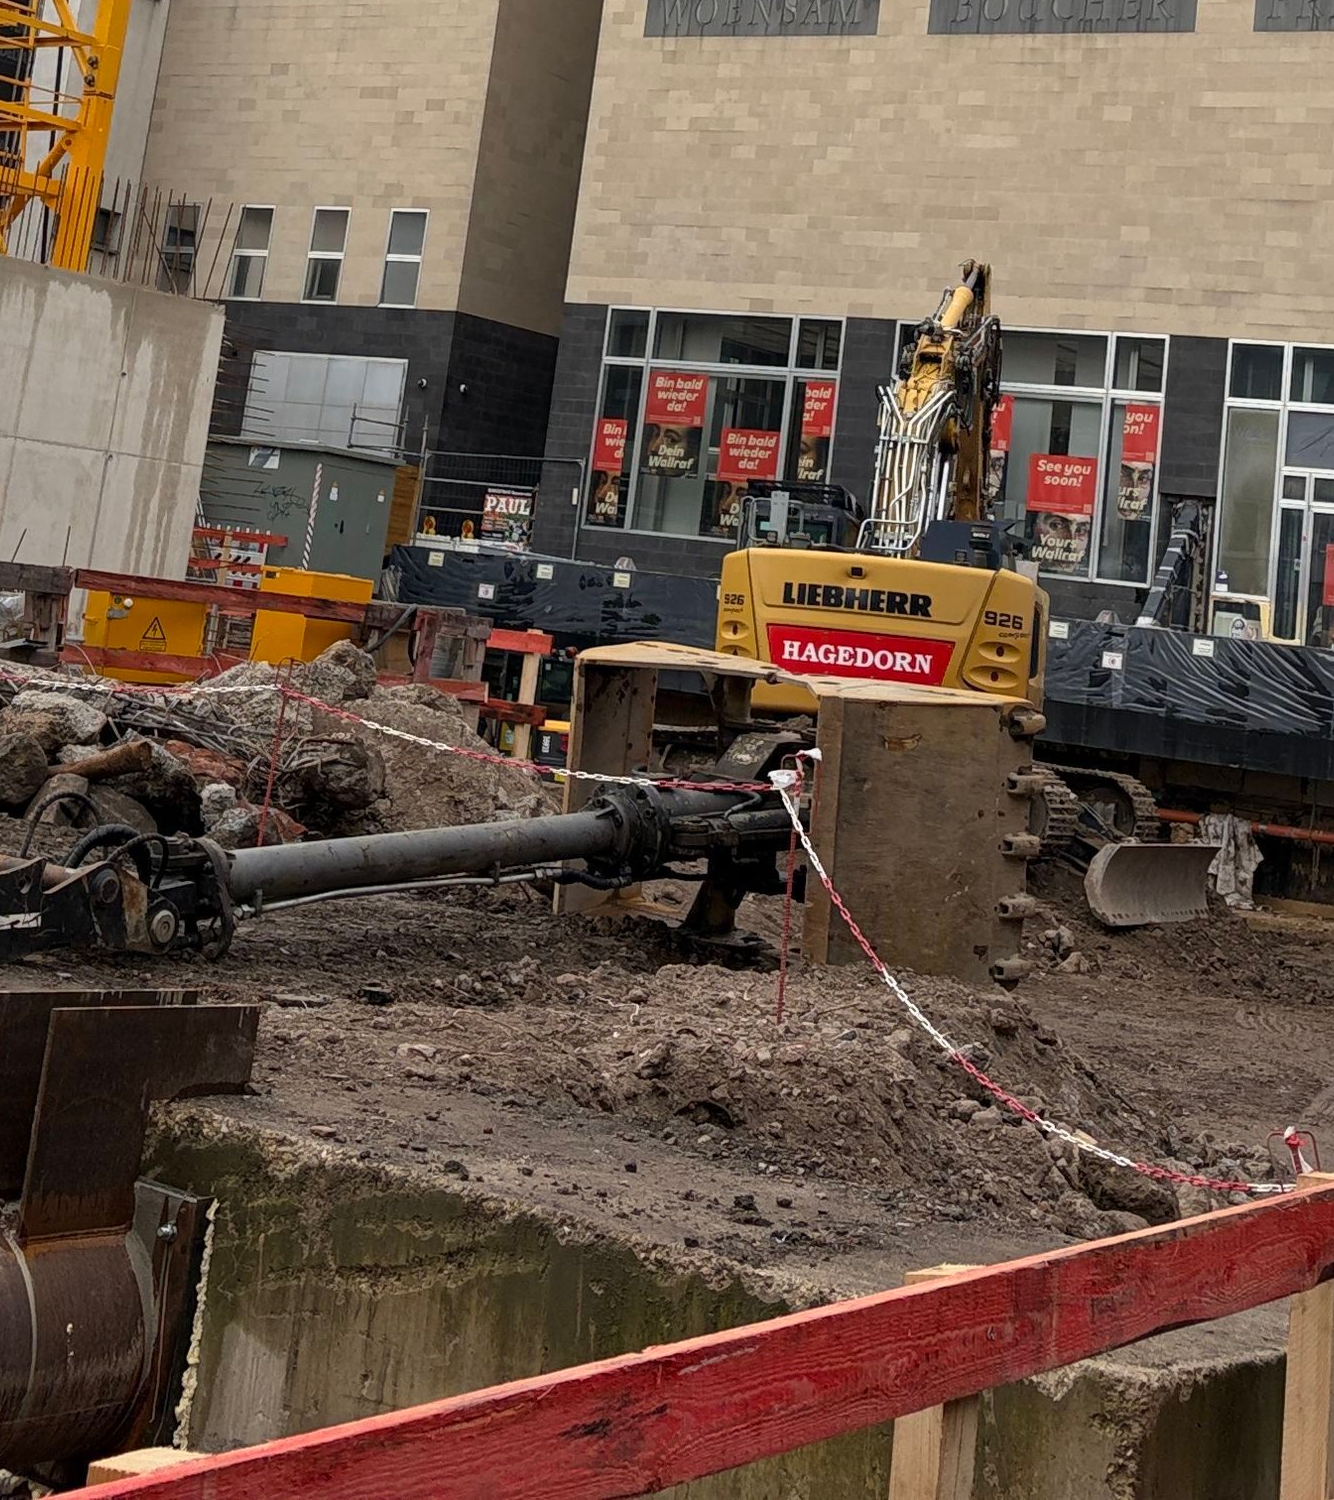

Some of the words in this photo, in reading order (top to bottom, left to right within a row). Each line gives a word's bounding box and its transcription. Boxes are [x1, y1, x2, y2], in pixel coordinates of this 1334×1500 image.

[655, 376, 674, 388] Bin
[676, 378, 703, 389] bald
[657, 390, 699, 401] wieder
[667, 401, 687, 412] da!
[726, 433, 746, 445] Bin
[748, 435, 777, 447] bald
[658, 445, 684, 457] Dein
[729, 447, 771, 459] wieder
[649, 456, 694, 469] Wallraf
[738, 459, 759, 470] da!
[1037, 459, 1062, 473] See
[1064, 463, 1091, 476] you
[1044, 474, 1083, 487] soon!
[485, 496, 531, 515] PAUL
[1040, 534, 1079, 548] Yours
[1032, 546, 1085, 562] Wallraf
[724, 593, 745, 605] 926
[783, 581, 932, 618] LIEBHERR
[983, 611, 1024, 630] 926
[782, 640, 933, 674] HAGEDORN
